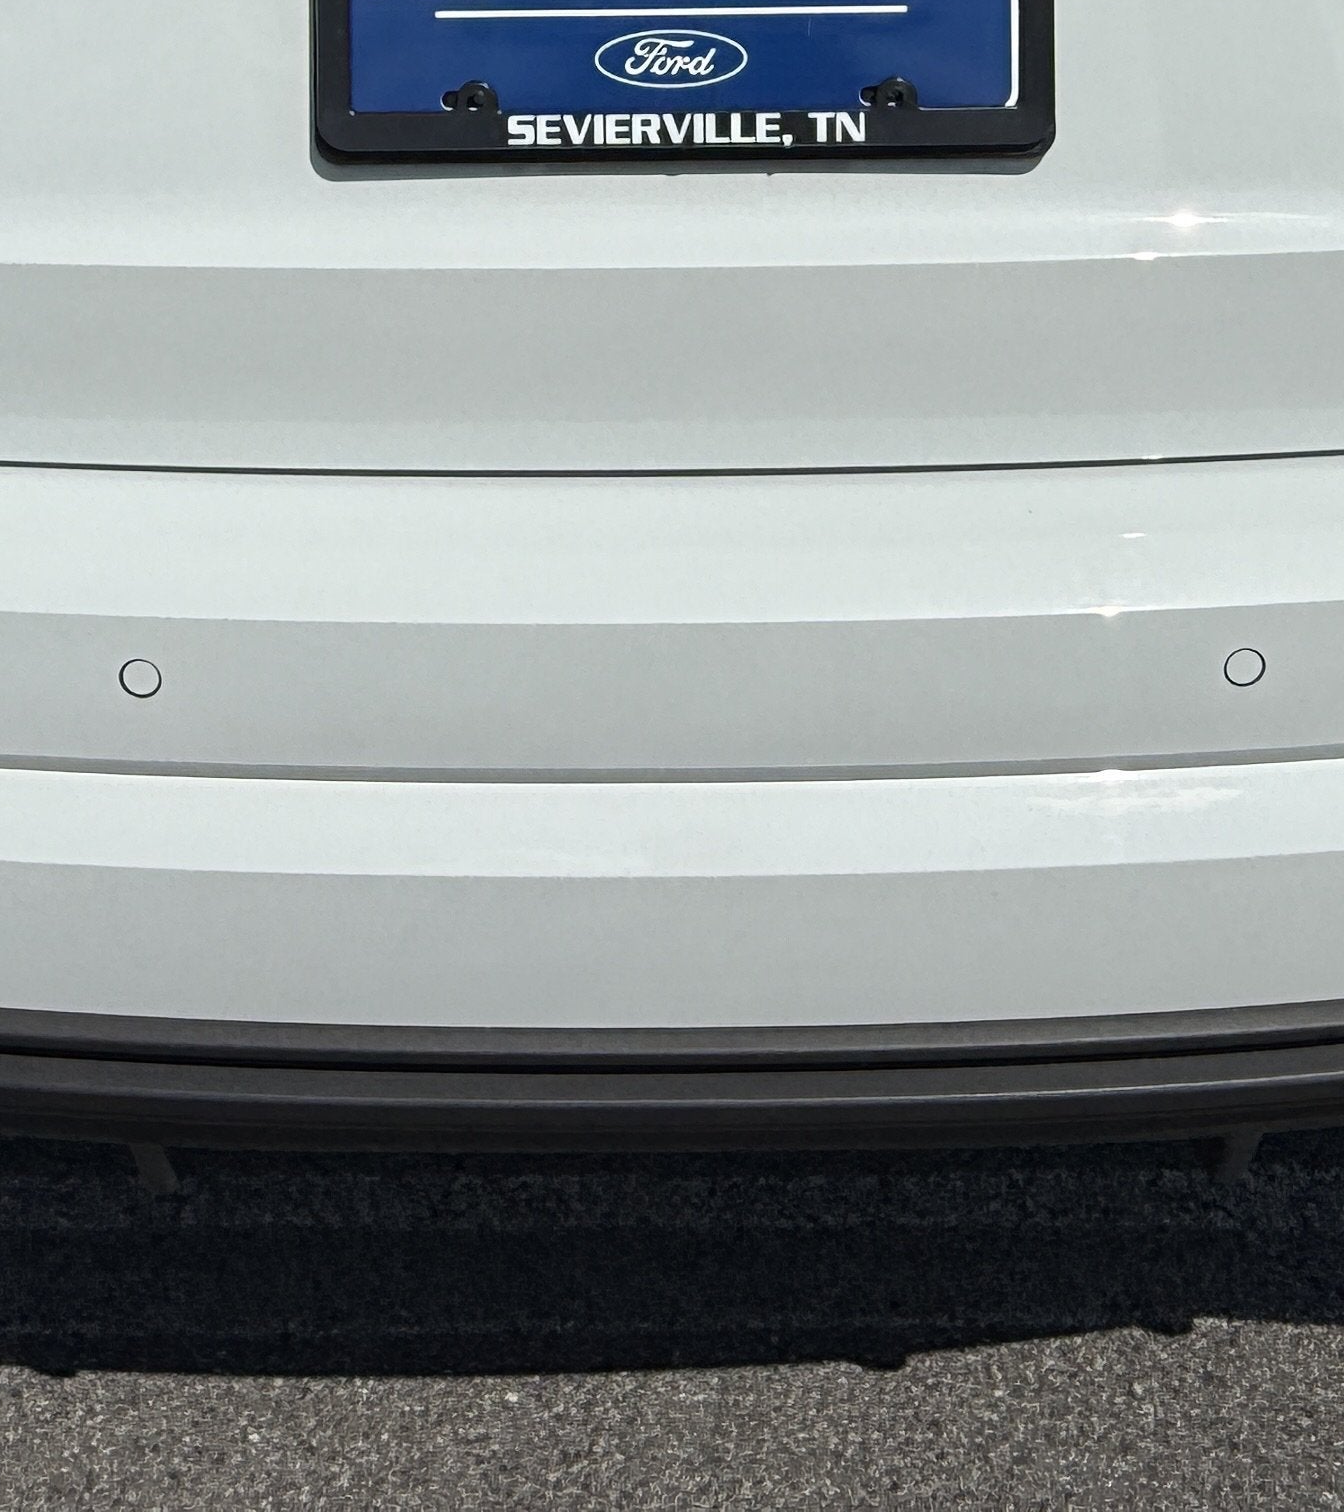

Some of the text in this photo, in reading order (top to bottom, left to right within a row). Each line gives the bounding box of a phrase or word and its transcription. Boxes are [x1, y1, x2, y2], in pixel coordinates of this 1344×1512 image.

[624, 35, 717, 78] Ford
[506, 110, 867, 148] SEVIERVILLE, TN
